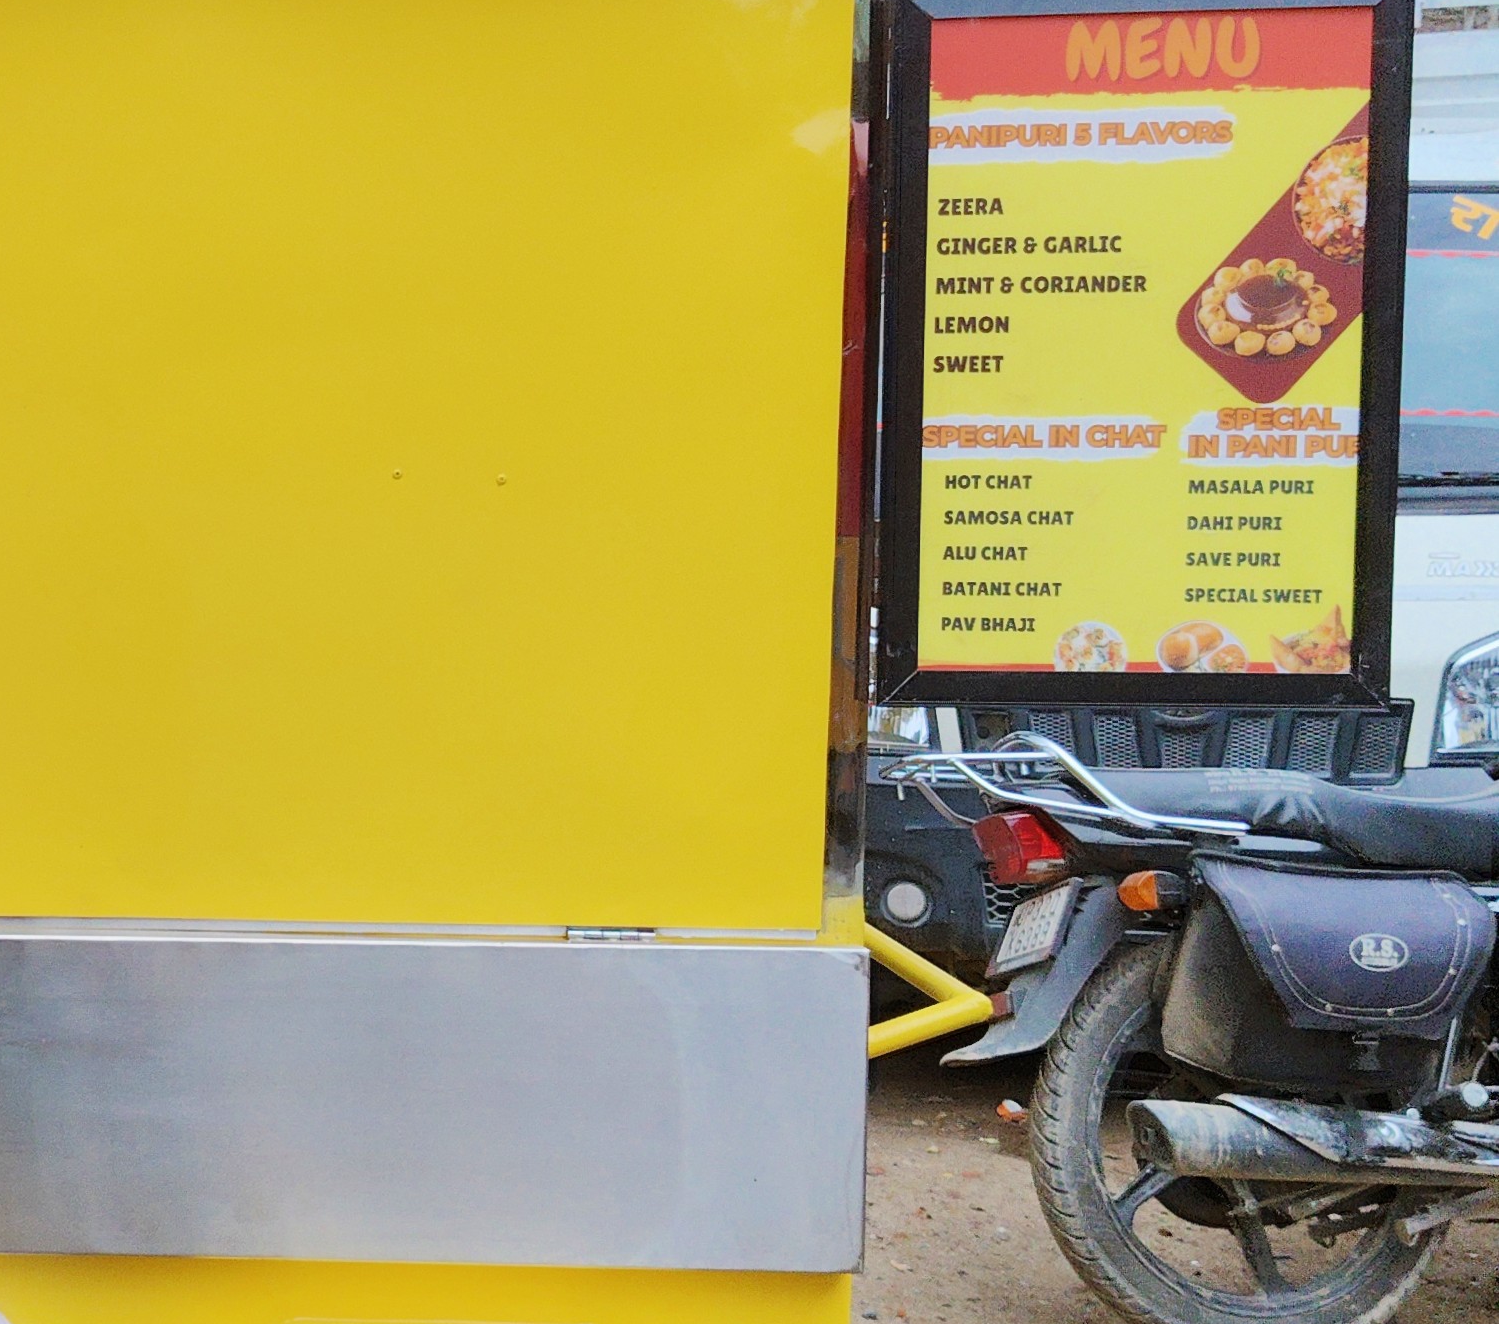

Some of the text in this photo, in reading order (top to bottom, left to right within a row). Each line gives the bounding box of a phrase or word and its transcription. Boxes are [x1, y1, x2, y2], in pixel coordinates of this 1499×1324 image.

[1065, 16, 1261, 82] MENU
[929, 120, 1234, 150] PANIPURI 5 FLAVORS
[938, 198, 1004, 216] ZEERA
[936, 235, 1122, 255] GINGER & GARLIC
[935, 275, 1147, 295] MINT & CORIANDER
[934, 316, 1009, 334] LEMON
[933, 355, 1004, 373] SWEET
[1216, 407, 1341, 431] SPECIAL
[922, 424, 1167, 448] SPECIAL IN CHAT
[1187, 434, 1219, 458] IN
[1226, 434, 1297, 458] PANI
[945, 475, 1032, 490] HOT CHAT
[1188, 480, 1314, 494] MASALA PURI
[944, 510, 1074, 525] SAMOSA CHAT
[1187, 516, 1282, 531] DAHI PURI
[942, 546, 1028, 561] ALU CHAT
[1185, 552, 1281, 567] SAVE PURI
[942, 581, 1062, 597] BATANI CHAT
[1184, 588, 1323, 603] SPECIAL SWEET
[941, 617, 1036, 632] PAV BHAJI
